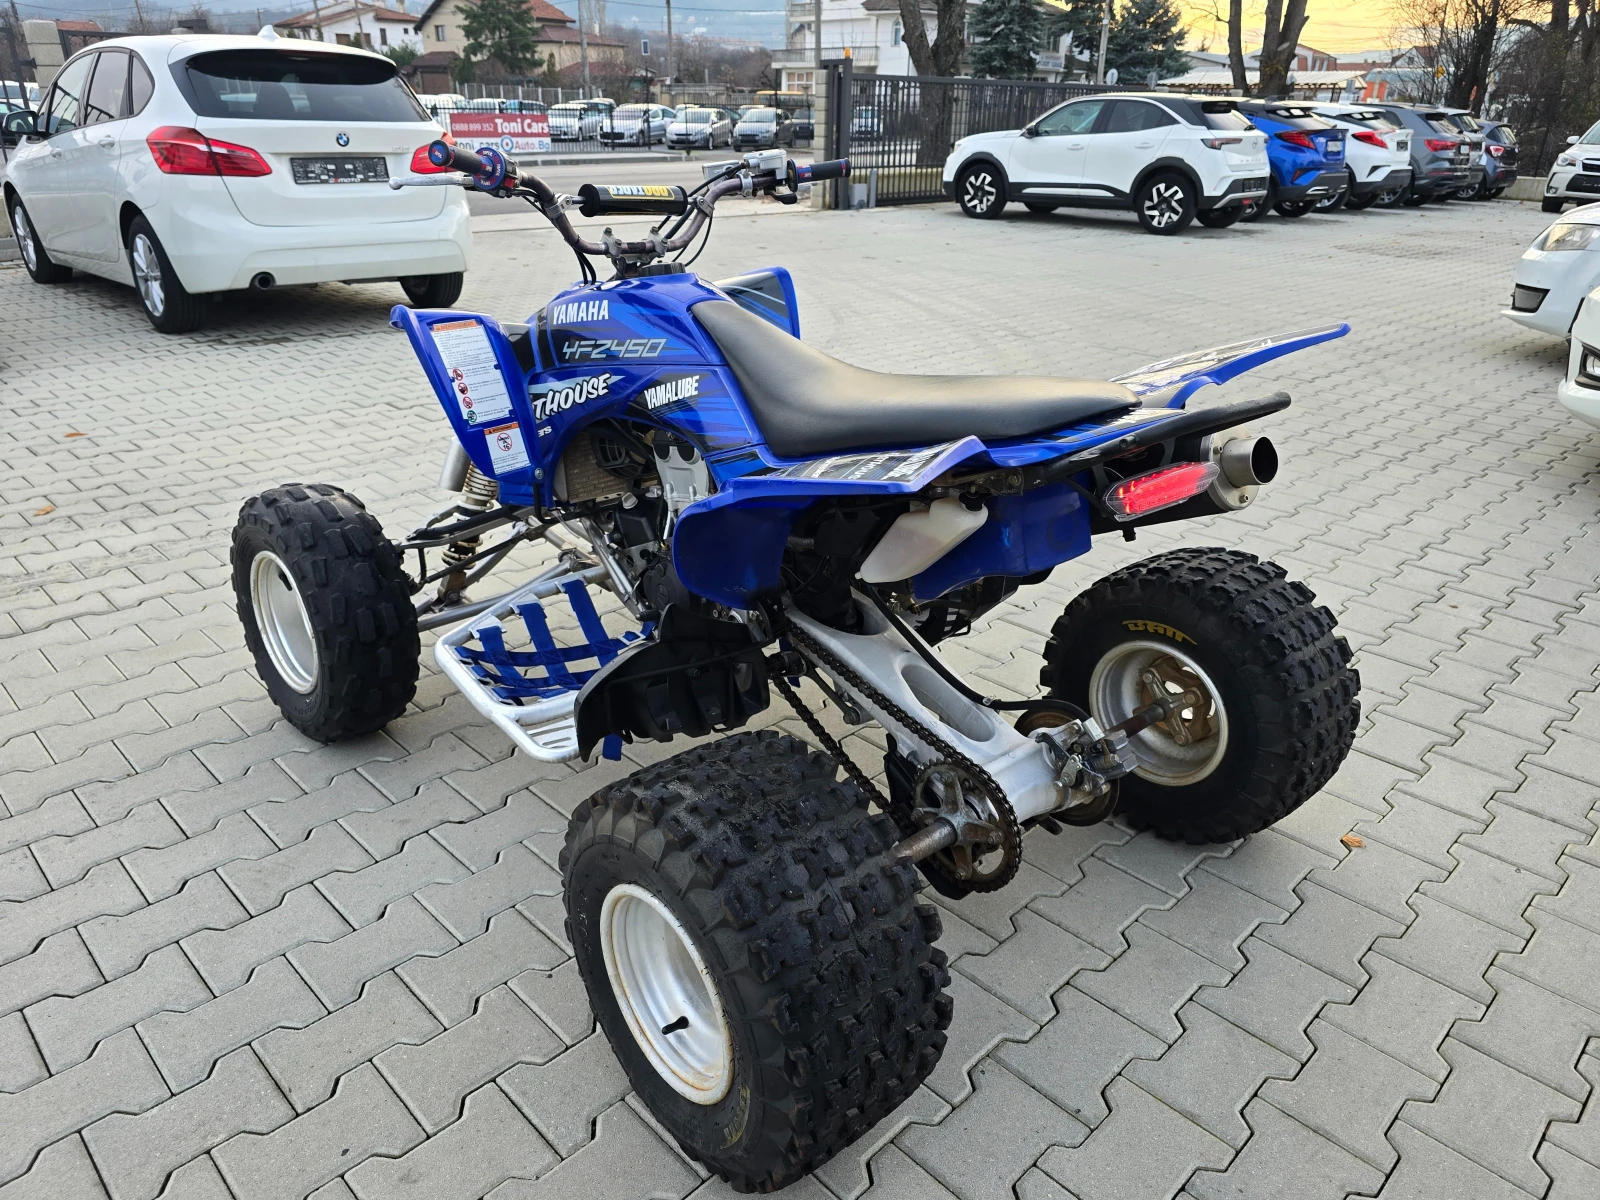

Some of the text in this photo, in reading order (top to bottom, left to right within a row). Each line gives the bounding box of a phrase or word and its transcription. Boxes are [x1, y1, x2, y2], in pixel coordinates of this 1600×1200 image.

[495, 118, 549, 134] Toni Cars
[553, 300, 609, 325] YAMAHA
[562, 338, 668, 360] YFZ450
[532, 373, 611, 419] THOUSE
[643, 375, 700, 410] YAMALUBE
